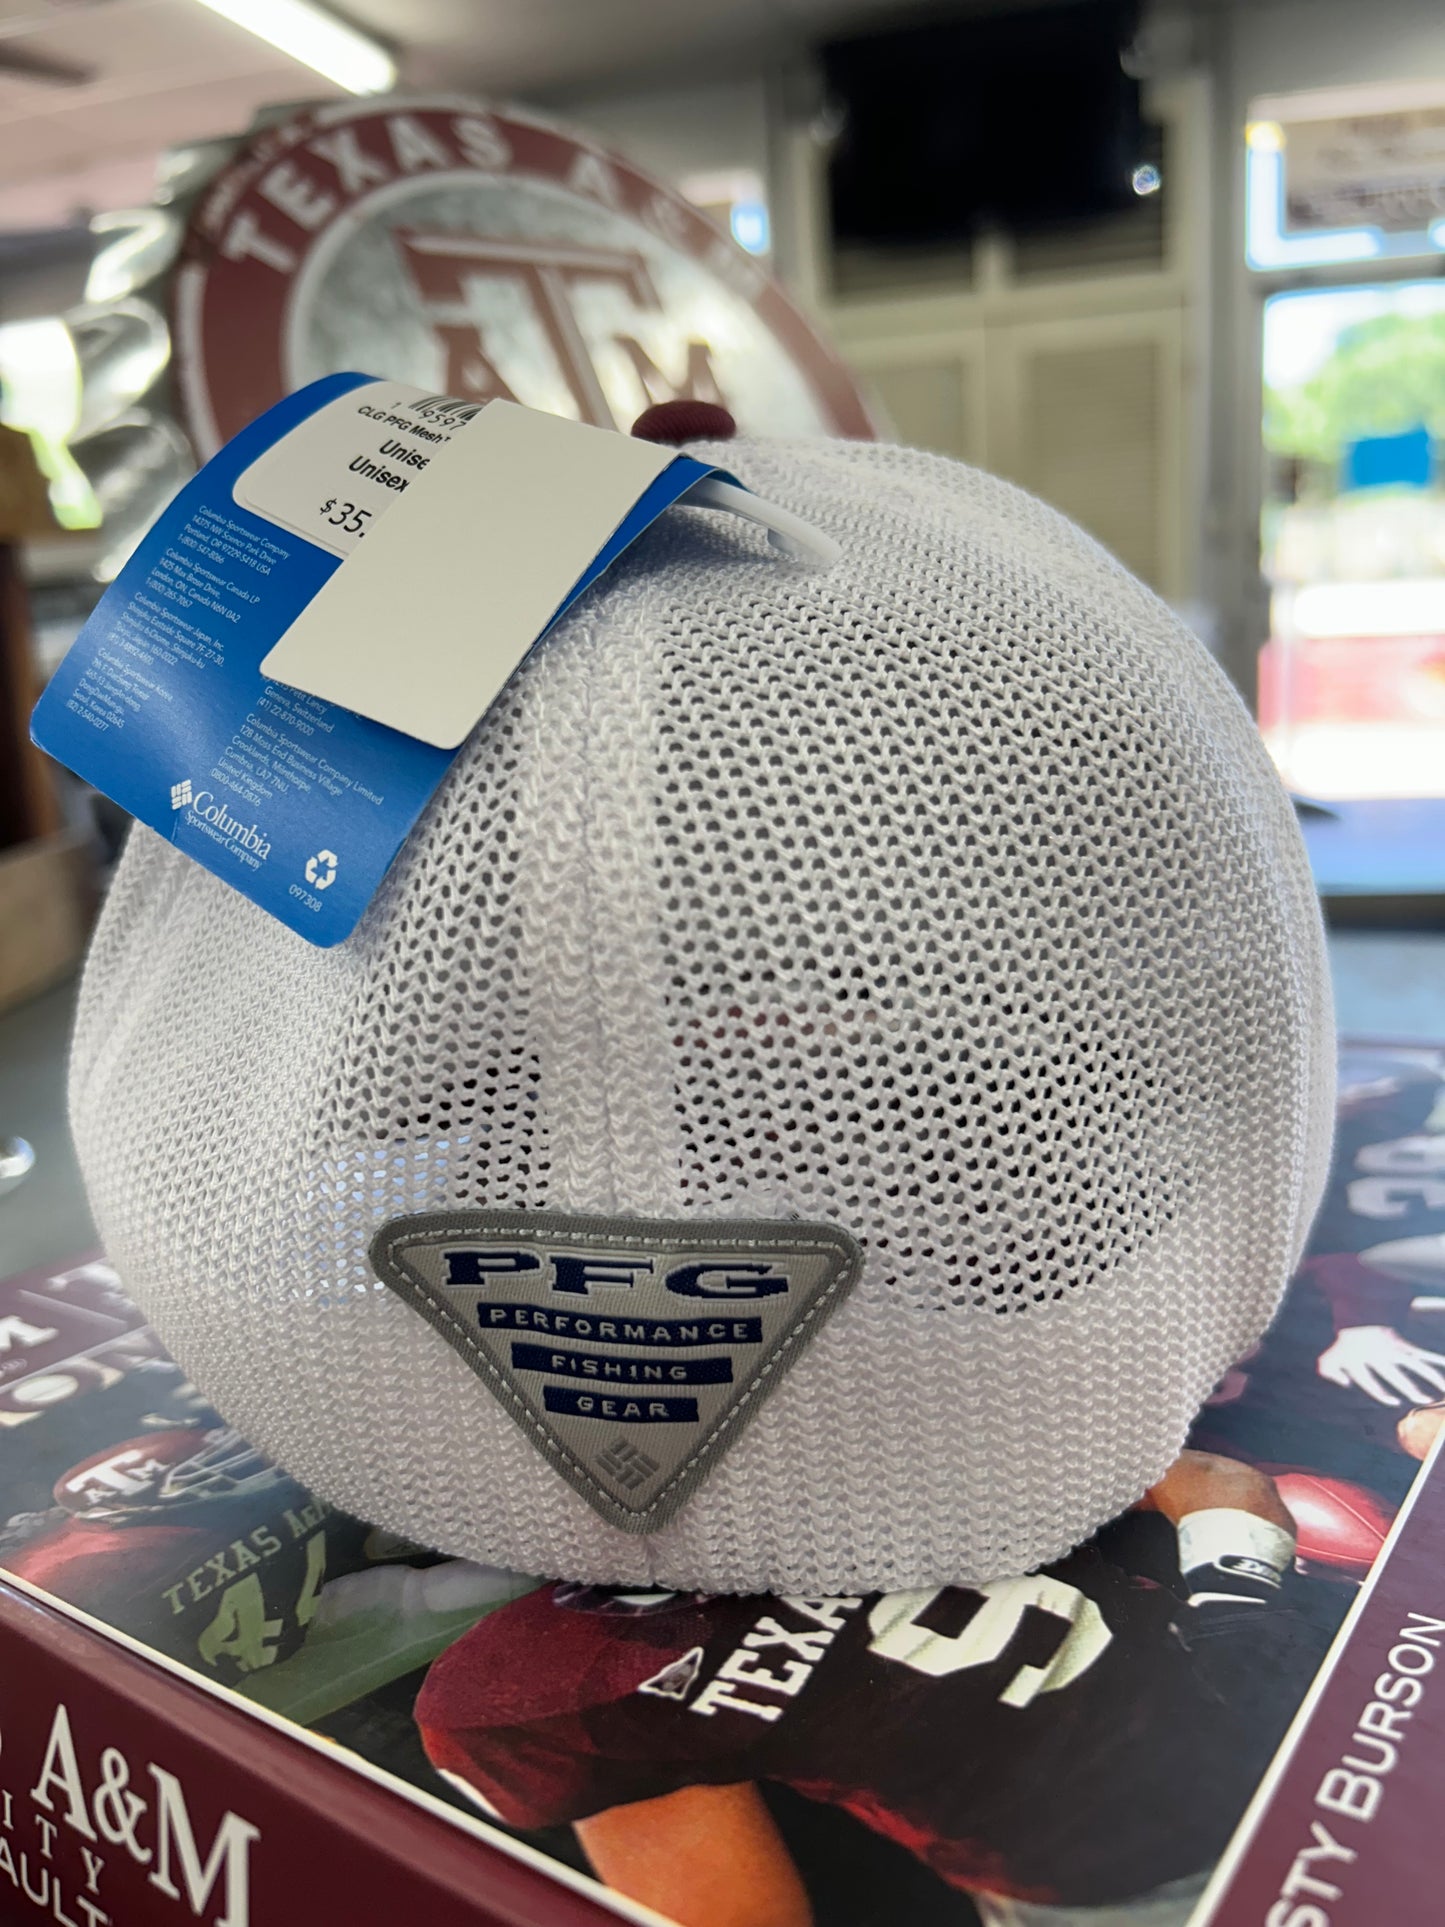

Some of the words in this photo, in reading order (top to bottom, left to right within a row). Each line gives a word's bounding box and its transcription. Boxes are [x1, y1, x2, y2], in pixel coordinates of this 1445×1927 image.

[219, 115, 513, 275] TEXAS
[357, 405, 387, 421] CLG
[383, 414, 413, 431] PFG
[378, 439, 431, 471] Unise
[199, 505, 226, 524] Columbia
[260, 539, 290, 560] Company
[320, 498, 373, 538] $35.
[166, 548, 193, 568] Columbia
[192, 563, 226, 586] Sportswear
[226, 582, 250, 600] Canada
[249, 596, 260, 604] LP
[210, 538, 222, 548] OR
[256, 564, 271, 575] USA
[245, 543, 259, 555] Park
[259, 551, 276, 564] Drive
[188, 588, 211, 606] Canada
[292, 703, 335, 733] Switzerland
[304, 697, 328, 716] Lancy
[217, 756, 243, 777] United
[241, 772, 273, 799] Kingdom
[246, 712, 278, 738] Columbia
[278, 734, 318, 763] Sportswear
[318, 758, 353, 787] Company
[353, 781, 384, 806] Limited
[252, 733, 272, 750] Moss
[271, 744, 288, 760] End
[286, 754, 317, 780] Business
[318, 774, 343, 796] Village
[184, 810, 227, 845] Sportswear
[224, 837, 262, 872] Company
[193, 791, 272, 860] Columbia
[288, 884, 323, 913] 097308
[442, 1250, 790, 1299] PFG
[489, 1308, 749, 1341] PERFORMANCE
[551, 1354, 688, 1380] FISHING
[576, 1396, 670, 1417] GEAR
[161, 1526, 282, 1615] TEXAS
[688, 1593, 866, 1722] TEXA
[1264, 1820, 1358, 1927] STY
[1314, 1612, 1445, 1823] BURSON
[30, 1703, 261, 1927] A&M
[0, 1836, 112, 1927] AULT
